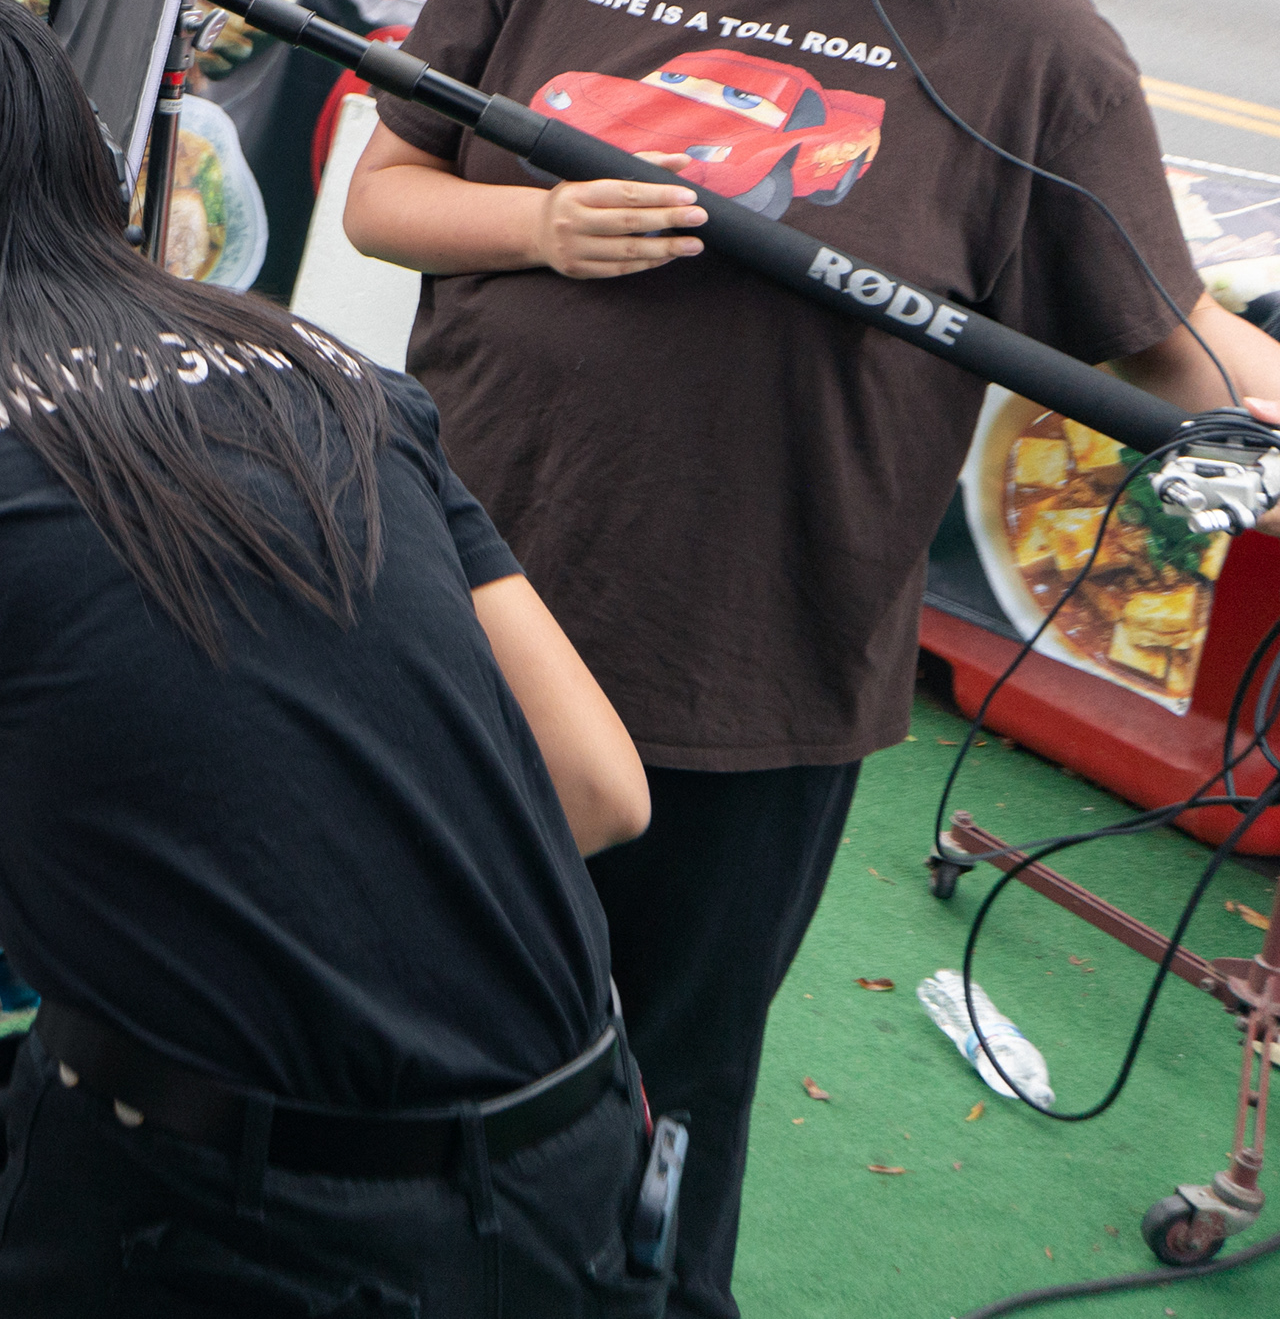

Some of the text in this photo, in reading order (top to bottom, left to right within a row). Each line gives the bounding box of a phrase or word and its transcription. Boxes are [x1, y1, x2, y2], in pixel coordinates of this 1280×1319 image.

[651, 1, 683, 27] IS
[686, 11, 709, 33] A
[718, 16, 794, 47] TOLL
[800, 30, 898, 70] ROAD.
[806, 246, 969, 346] RØDE
